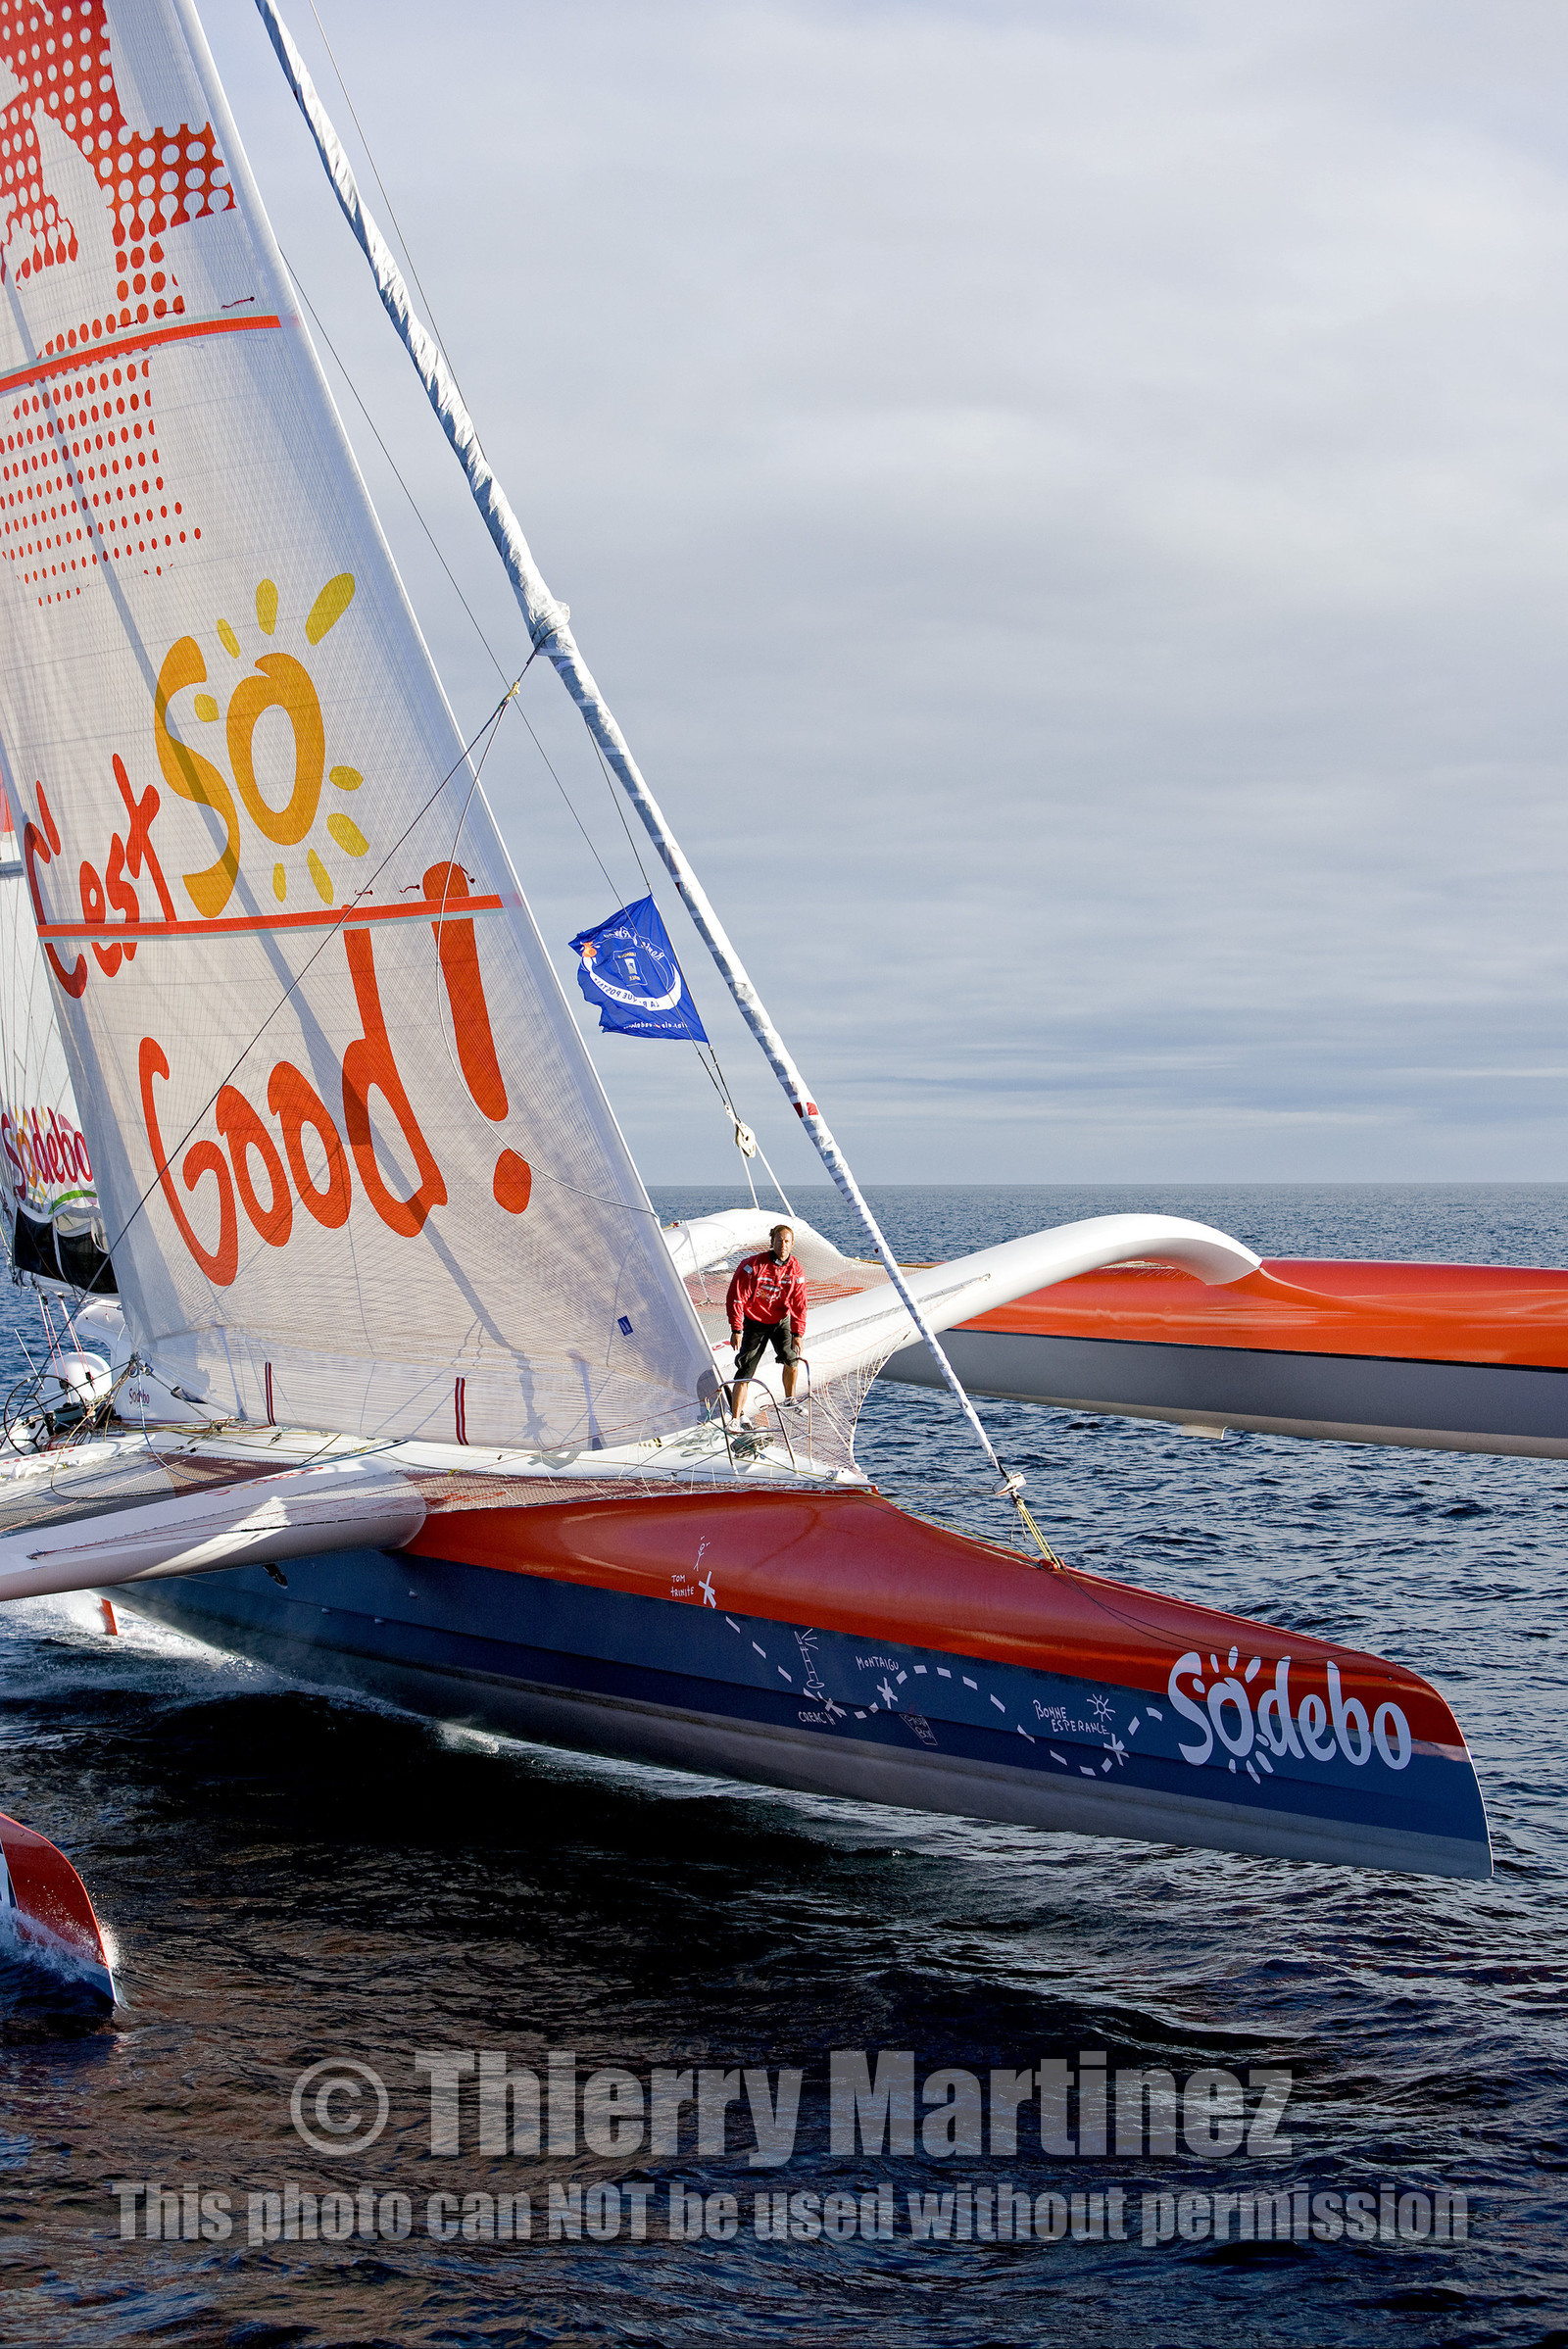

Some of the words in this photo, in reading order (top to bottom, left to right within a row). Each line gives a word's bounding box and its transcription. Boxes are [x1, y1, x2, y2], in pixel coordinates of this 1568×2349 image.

[24, 753, 177, 999] C'est
[1, 1106, 94, 1201] Sodebo
[671, 1574, 686, 1584] TOM
[1032, 1699, 1067, 1720] BONNE
[1051, 1719, 1110, 1735] ESPERANCE
[1168, 1650, 1412, 1771] Sodebo
